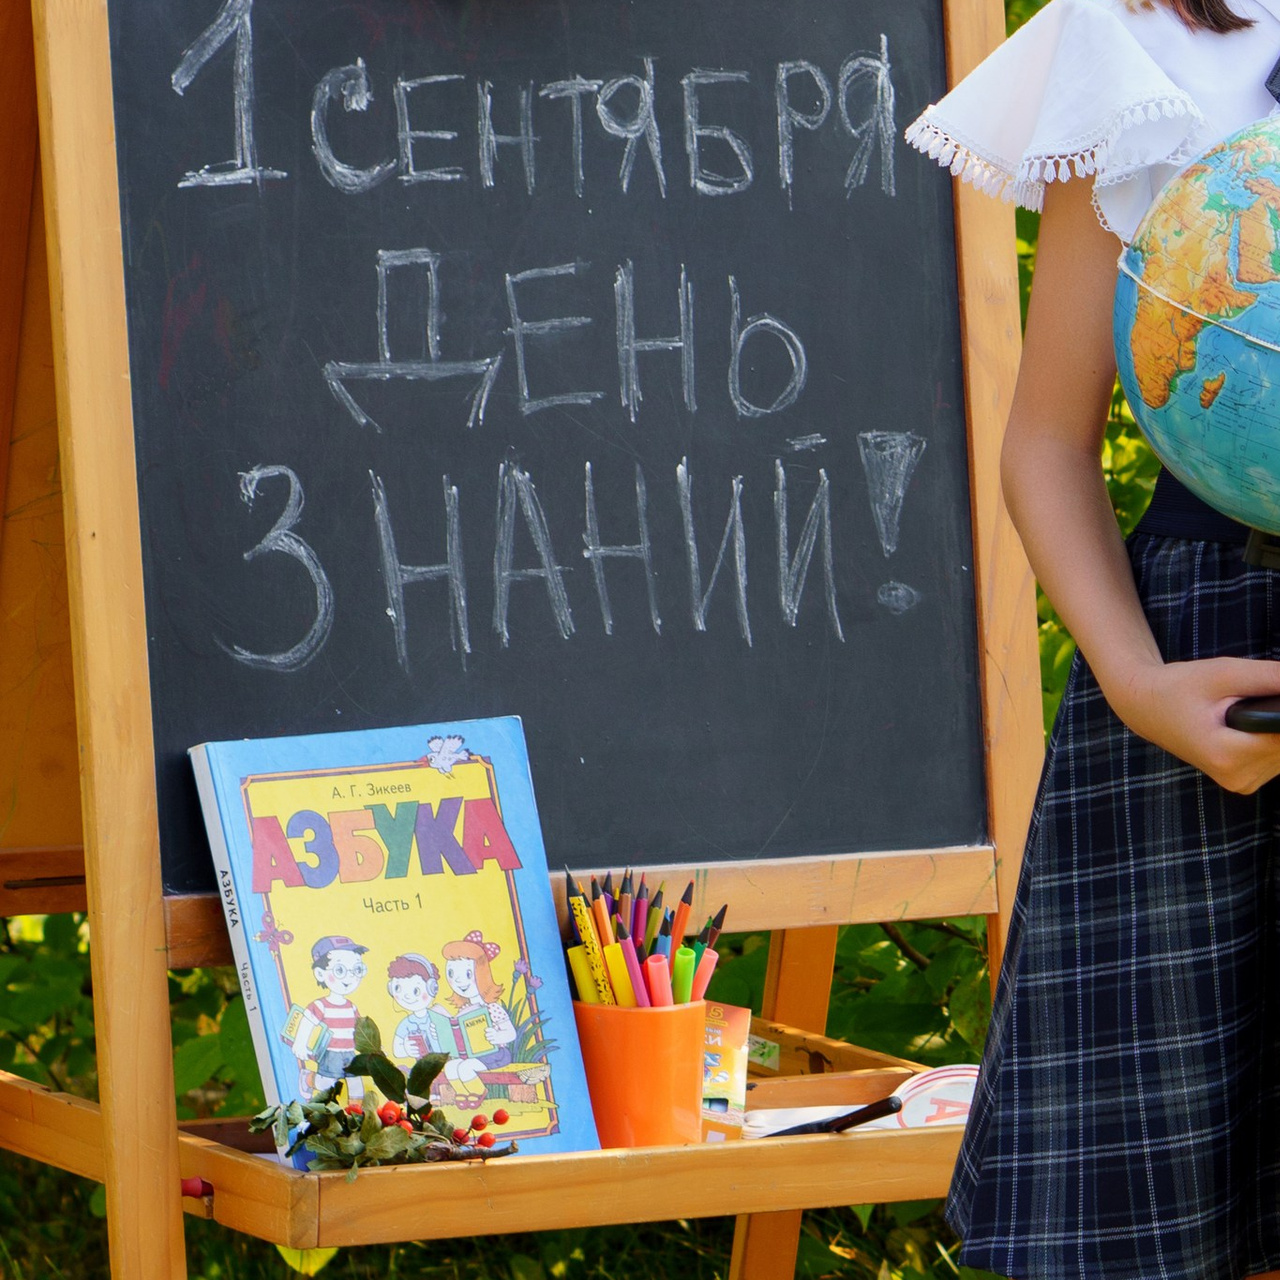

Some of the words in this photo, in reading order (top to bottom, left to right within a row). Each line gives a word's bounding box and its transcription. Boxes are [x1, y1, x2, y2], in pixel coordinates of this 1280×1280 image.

[310, 34, 898, 210] СЕНТЯБРЯ
[321, 248, 809, 434] ДЕНЬ
[252, 797, 523, 894] АЗБУКА
[332, 786, 345, 799] А.
[350, 785, 361, 797] Г.
[367, 782, 412, 796] Зикеев
[219, 870, 239, 928] АЗБУКА
[241, 962, 253, 1000] Часть
[363, 898, 410, 913] Часть
[415, 893, 423, 909] 1
